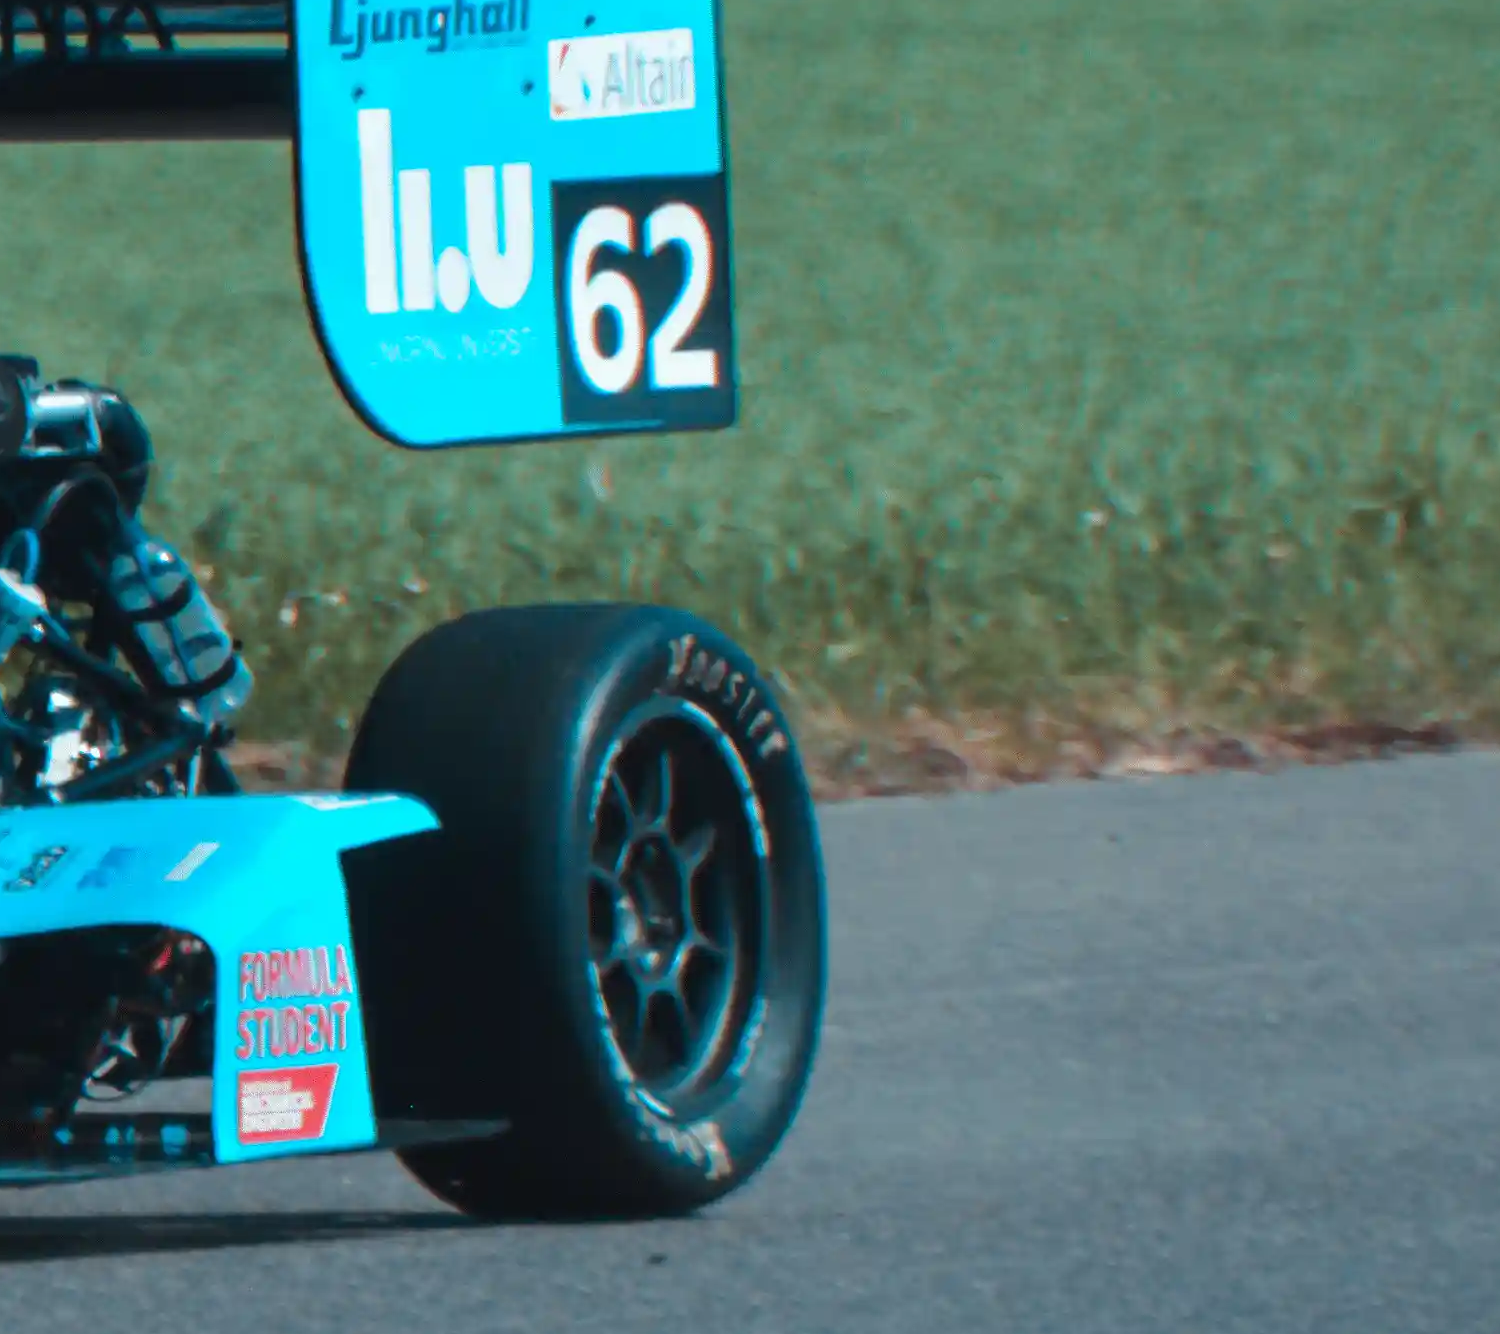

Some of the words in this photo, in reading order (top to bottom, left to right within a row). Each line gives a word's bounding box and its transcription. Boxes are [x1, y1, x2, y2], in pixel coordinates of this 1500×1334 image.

[601, 39, 696, 110] Altair
[567, 202, 718, 394] 62
[239, 944, 353, 1004] FORMULA
[235, 1000, 351, 1060] STUDENT
